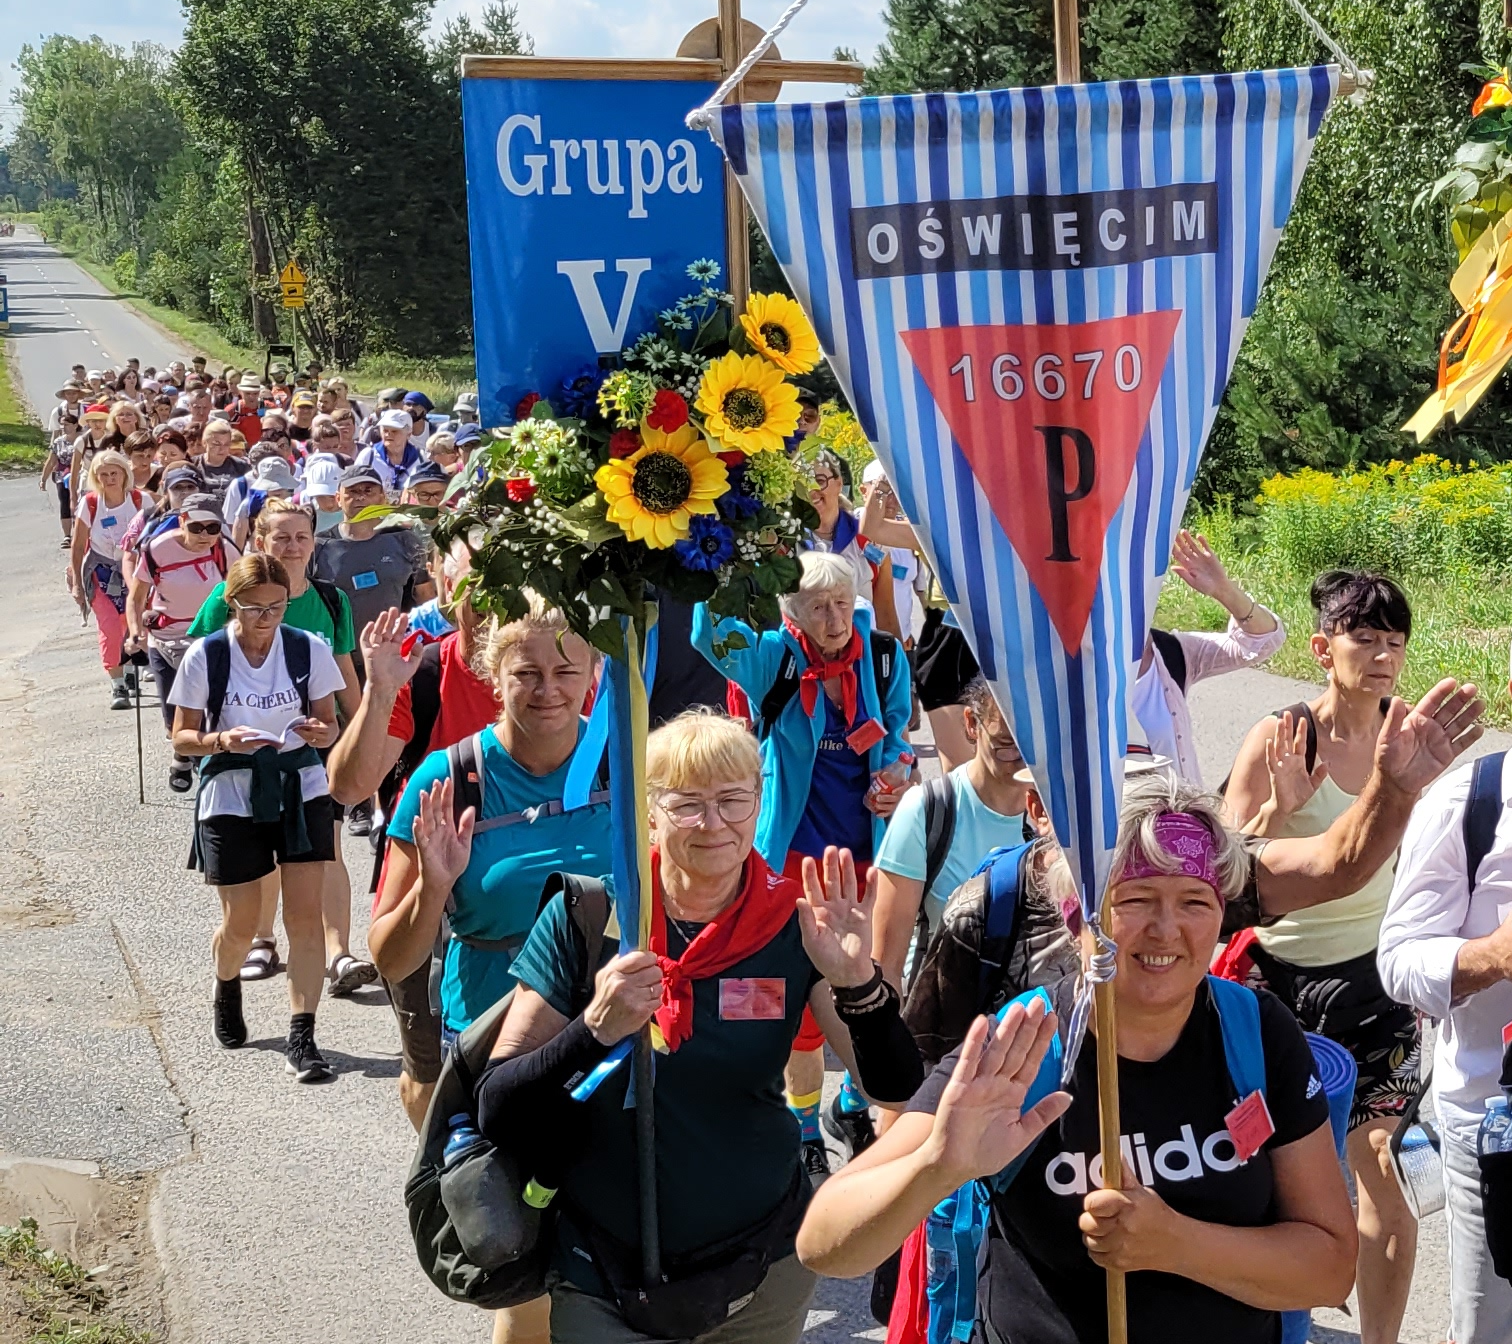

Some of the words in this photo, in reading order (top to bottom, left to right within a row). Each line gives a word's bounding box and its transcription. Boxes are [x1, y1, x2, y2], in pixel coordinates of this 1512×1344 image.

[496, 113, 703, 218] Grupa
[866, 199, 1206, 266] OŚWIĘCIM
[556, 258, 652, 353] V
[949, 343, 1143, 403] 16670
[1033, 425, 1096, 563] P
[1045, 1123, 1259, 1196] adida
